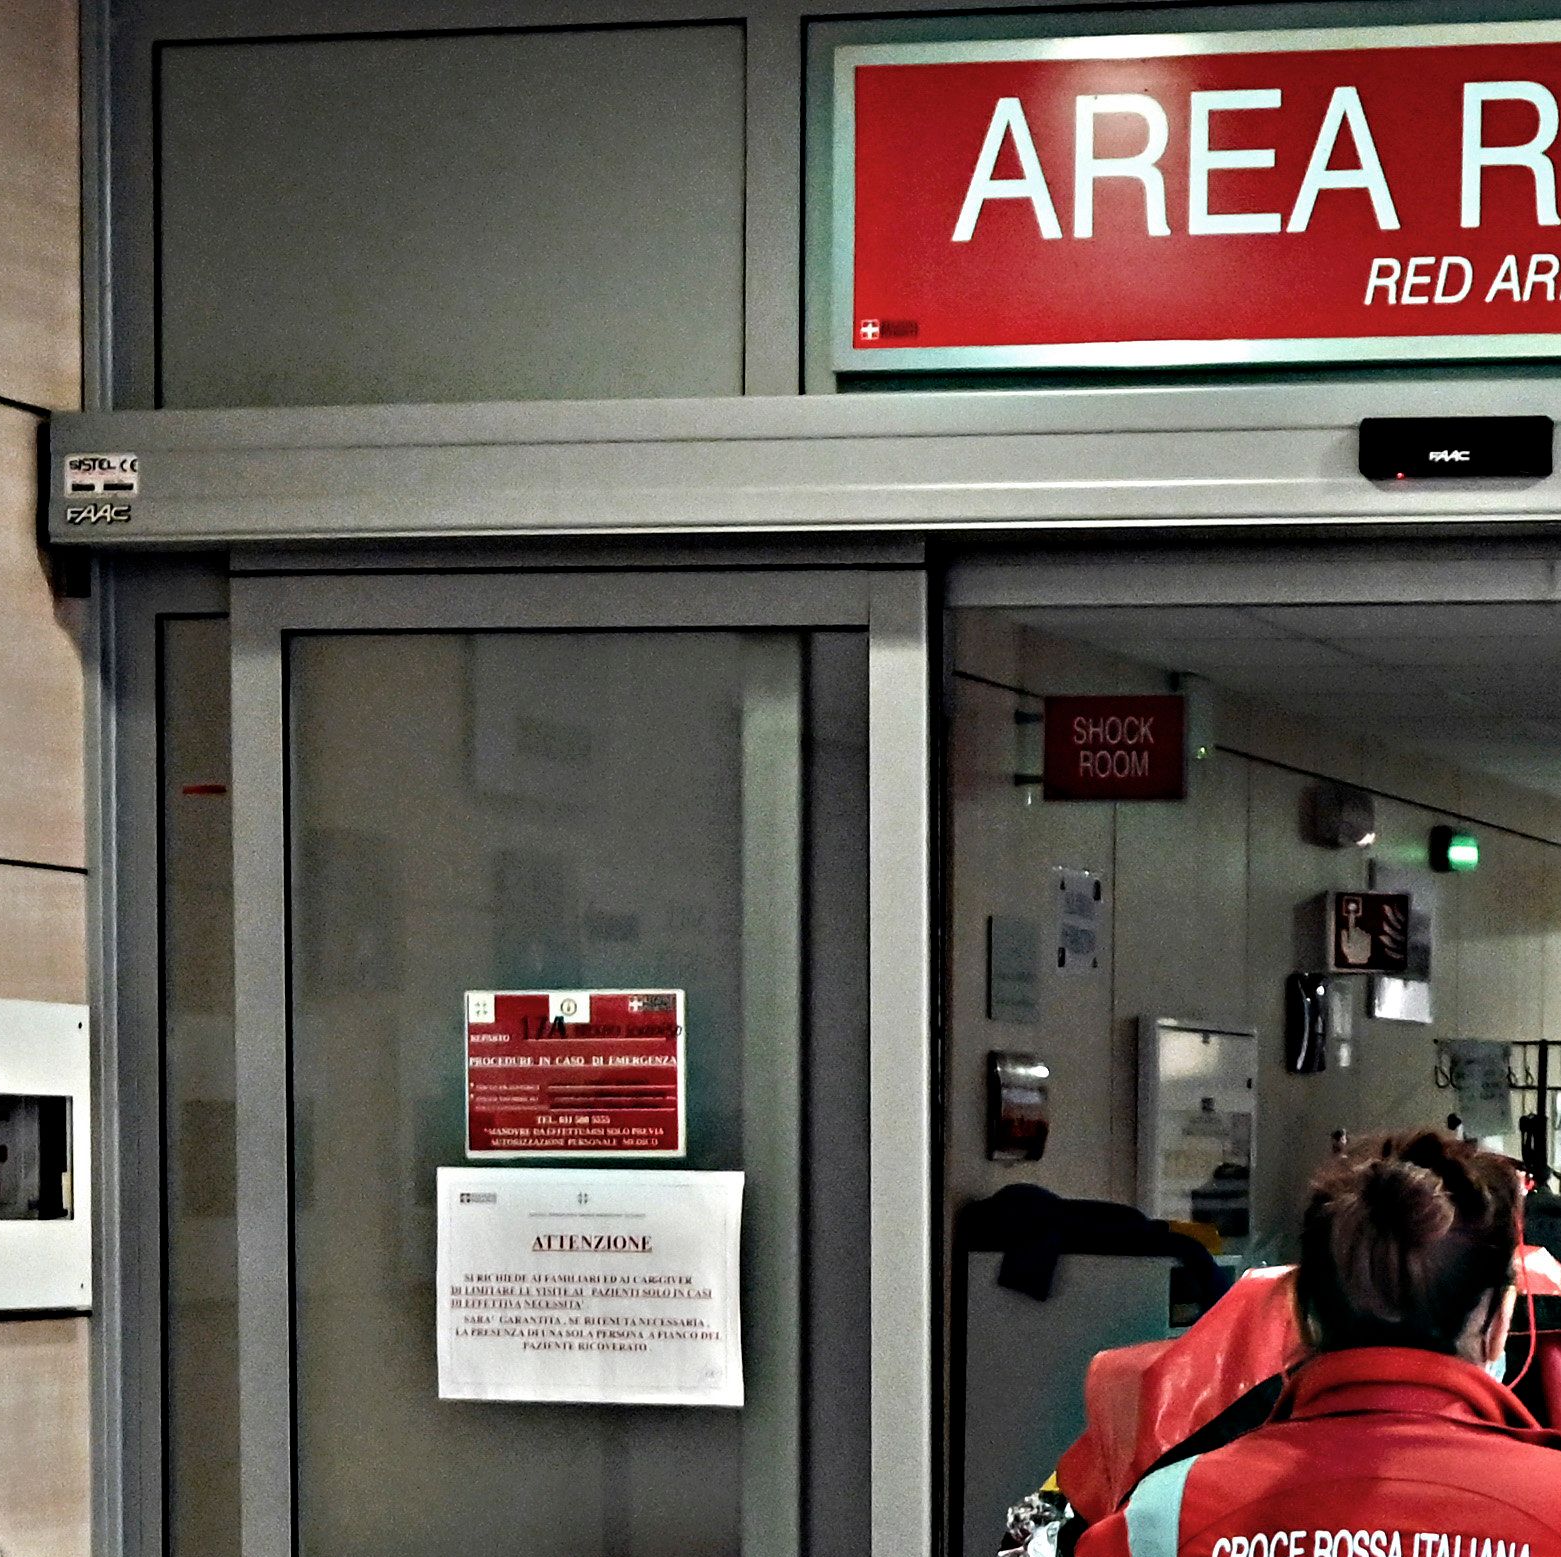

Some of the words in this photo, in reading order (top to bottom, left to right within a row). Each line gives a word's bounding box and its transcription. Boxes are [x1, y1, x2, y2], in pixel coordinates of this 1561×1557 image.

[952, 85, 1402, 243] AREA
[1365, 257, 1474, 307] RED
[1429, 450, 1471, 462] FAAC
[67, 504, 130, 523] FAAC
[1073, 716, 1154, 744] SHOCK
[1080, 750, 1149, 777] ROOM
[470, 1056, 533, 1066] PROCEDURE
[539, 1056, 551, 1066] IN
[555, 1056, 585, 1066] CASO
[592, 1056, 604, 1066] DI
[609, 1056, 676, 1066] EMERGENZA
[533, 1235, 652, 1250] ATTENZIONE
